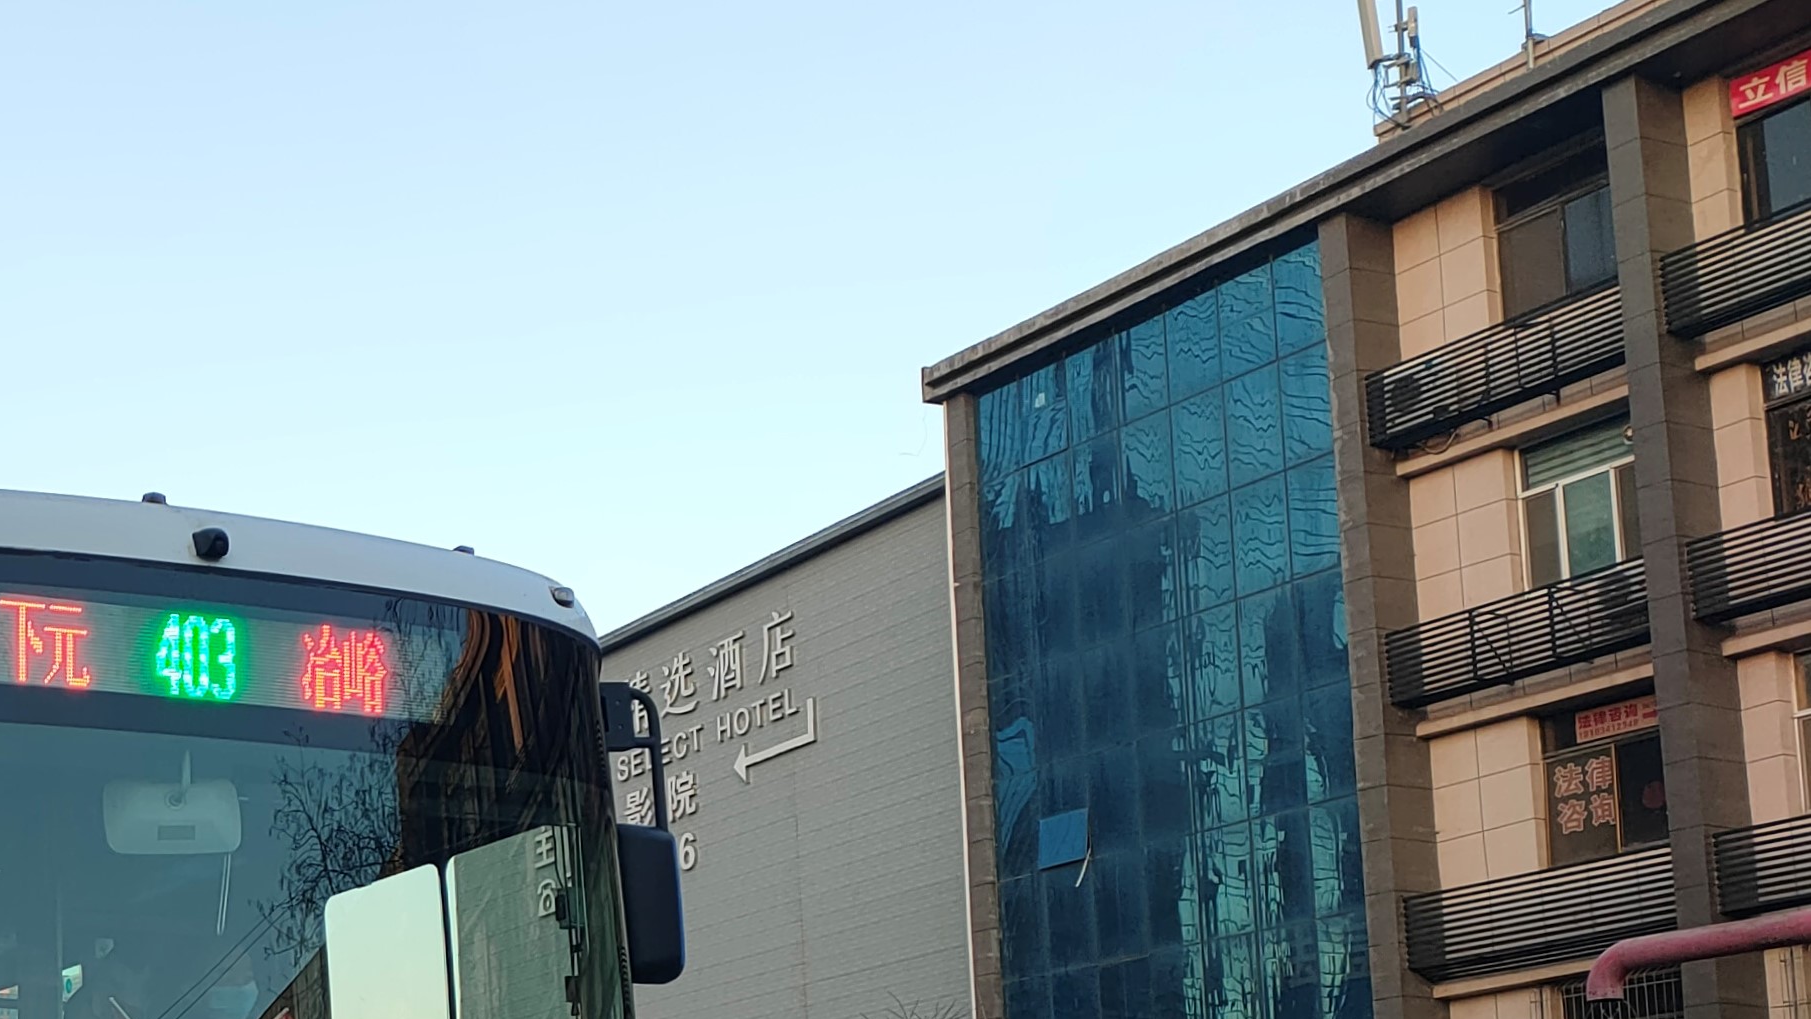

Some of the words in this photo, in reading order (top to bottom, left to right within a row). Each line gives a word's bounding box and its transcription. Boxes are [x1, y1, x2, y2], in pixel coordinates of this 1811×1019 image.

[1738, 59, 1809, 109] 立信
[154, 612, 238, 701] 403
[717, 688, 800, 742] HOTEL
[1553, 755, 1613, 798] 法律
[1557, 792, 1617, 835] 咨询
